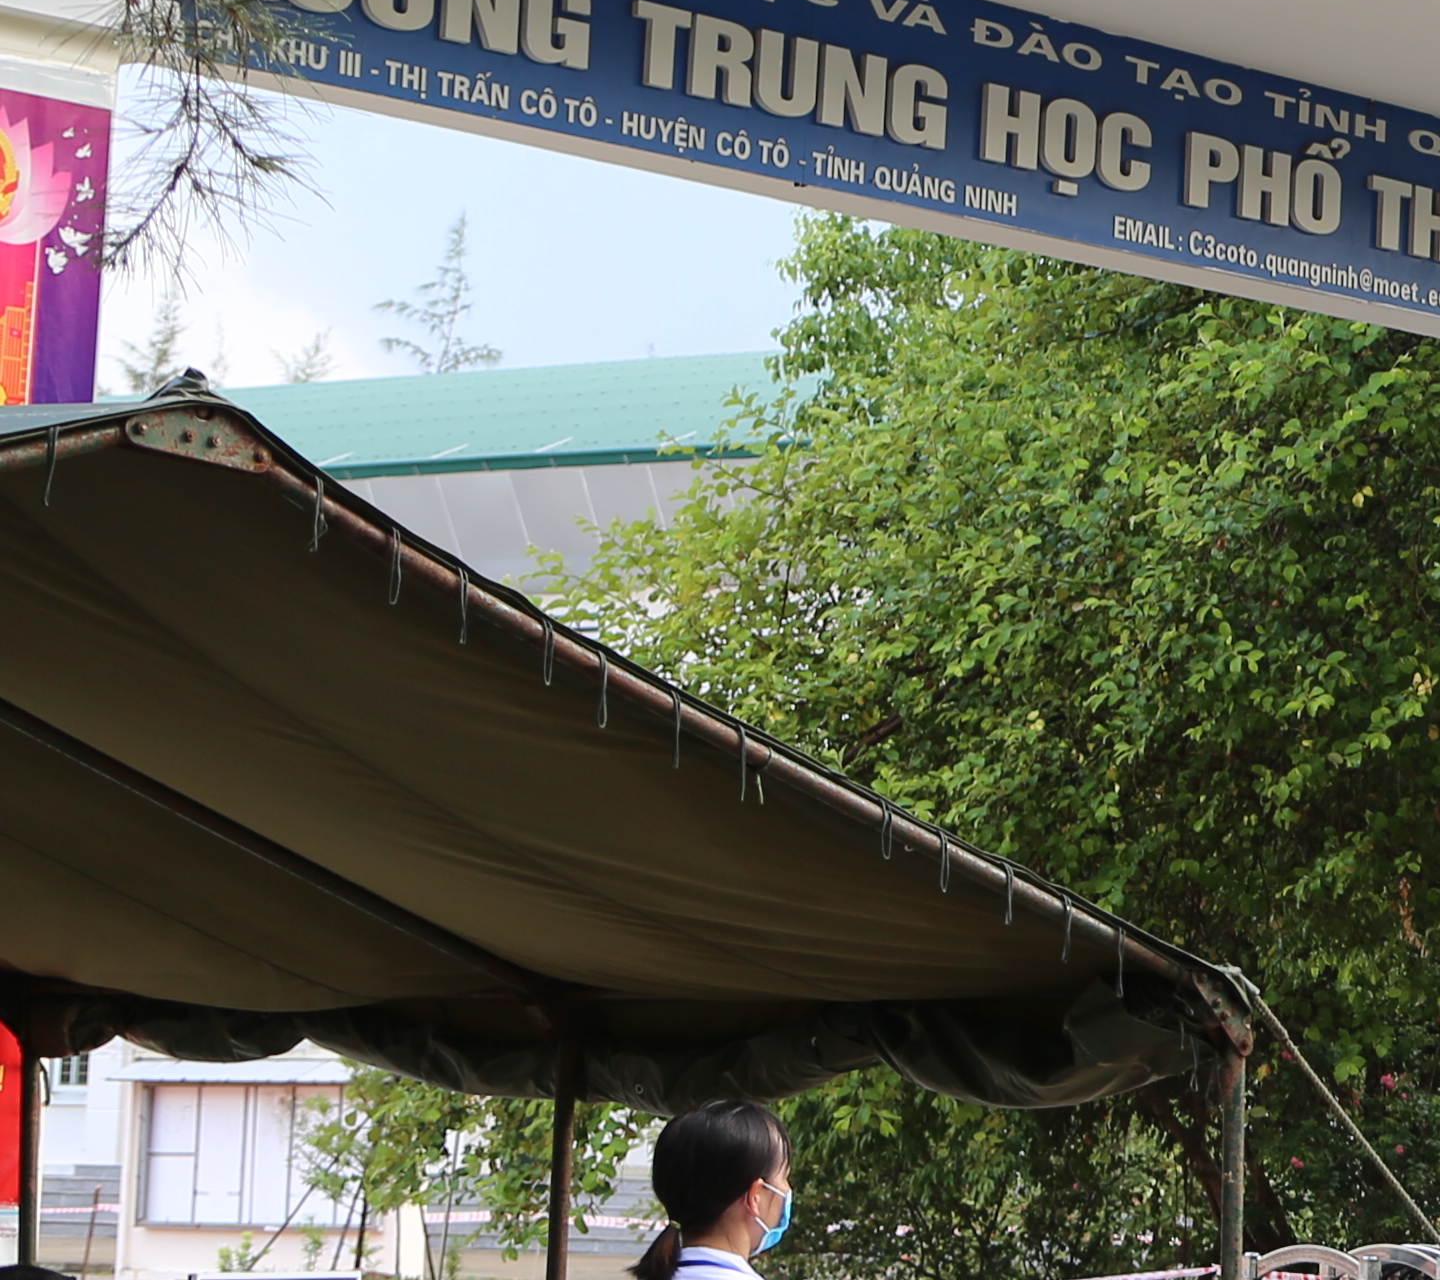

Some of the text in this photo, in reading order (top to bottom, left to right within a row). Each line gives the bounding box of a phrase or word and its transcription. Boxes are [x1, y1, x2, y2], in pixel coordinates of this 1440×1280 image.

[339, 49, 362, 78] III
[385, 59, 427, 98] THỊ
[437, 71, 510, 110] TRẤN
[519, 87, 557, 119] CÔ
[564, 95, 598, 128] TÔ
[621, 110, 706, 153] HUYỆN
[715, 130, 750, 161] CÔ
[758, 137, 790, 169] TÔ
[811, 145, 865, 185] TỈNH
[874, 162, 955, 204] QUẢNG
[963, 184, 1018, 216] NINH
[970, 19, 1103, 73] ĐÀO
[1125, 56, 1244, 107] TẠO
[1265, 88, 1388, 144] TỈNH
[980, 82, 1153, 197] HỌC
[1183, 136, 1351, 235] PHỔ
